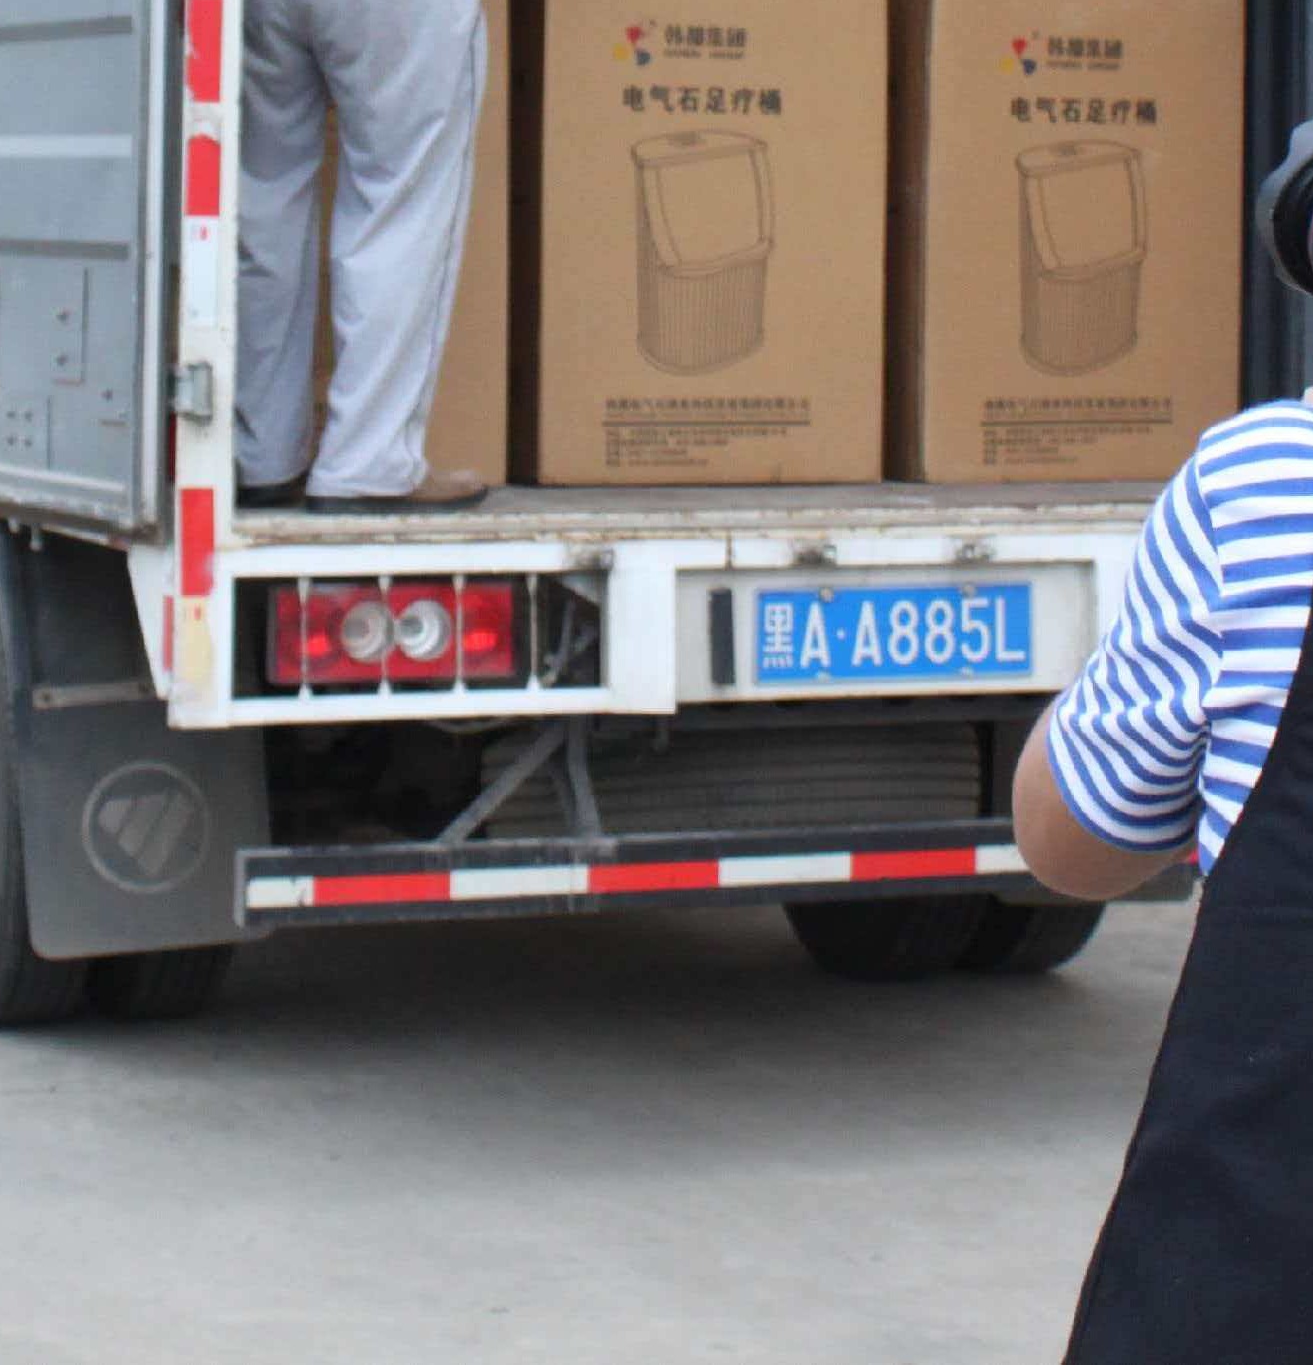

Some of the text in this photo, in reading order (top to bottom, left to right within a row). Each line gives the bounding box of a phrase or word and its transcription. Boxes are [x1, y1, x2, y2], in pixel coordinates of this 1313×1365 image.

[623, 85, 782, 115] 电气石足疗桶
